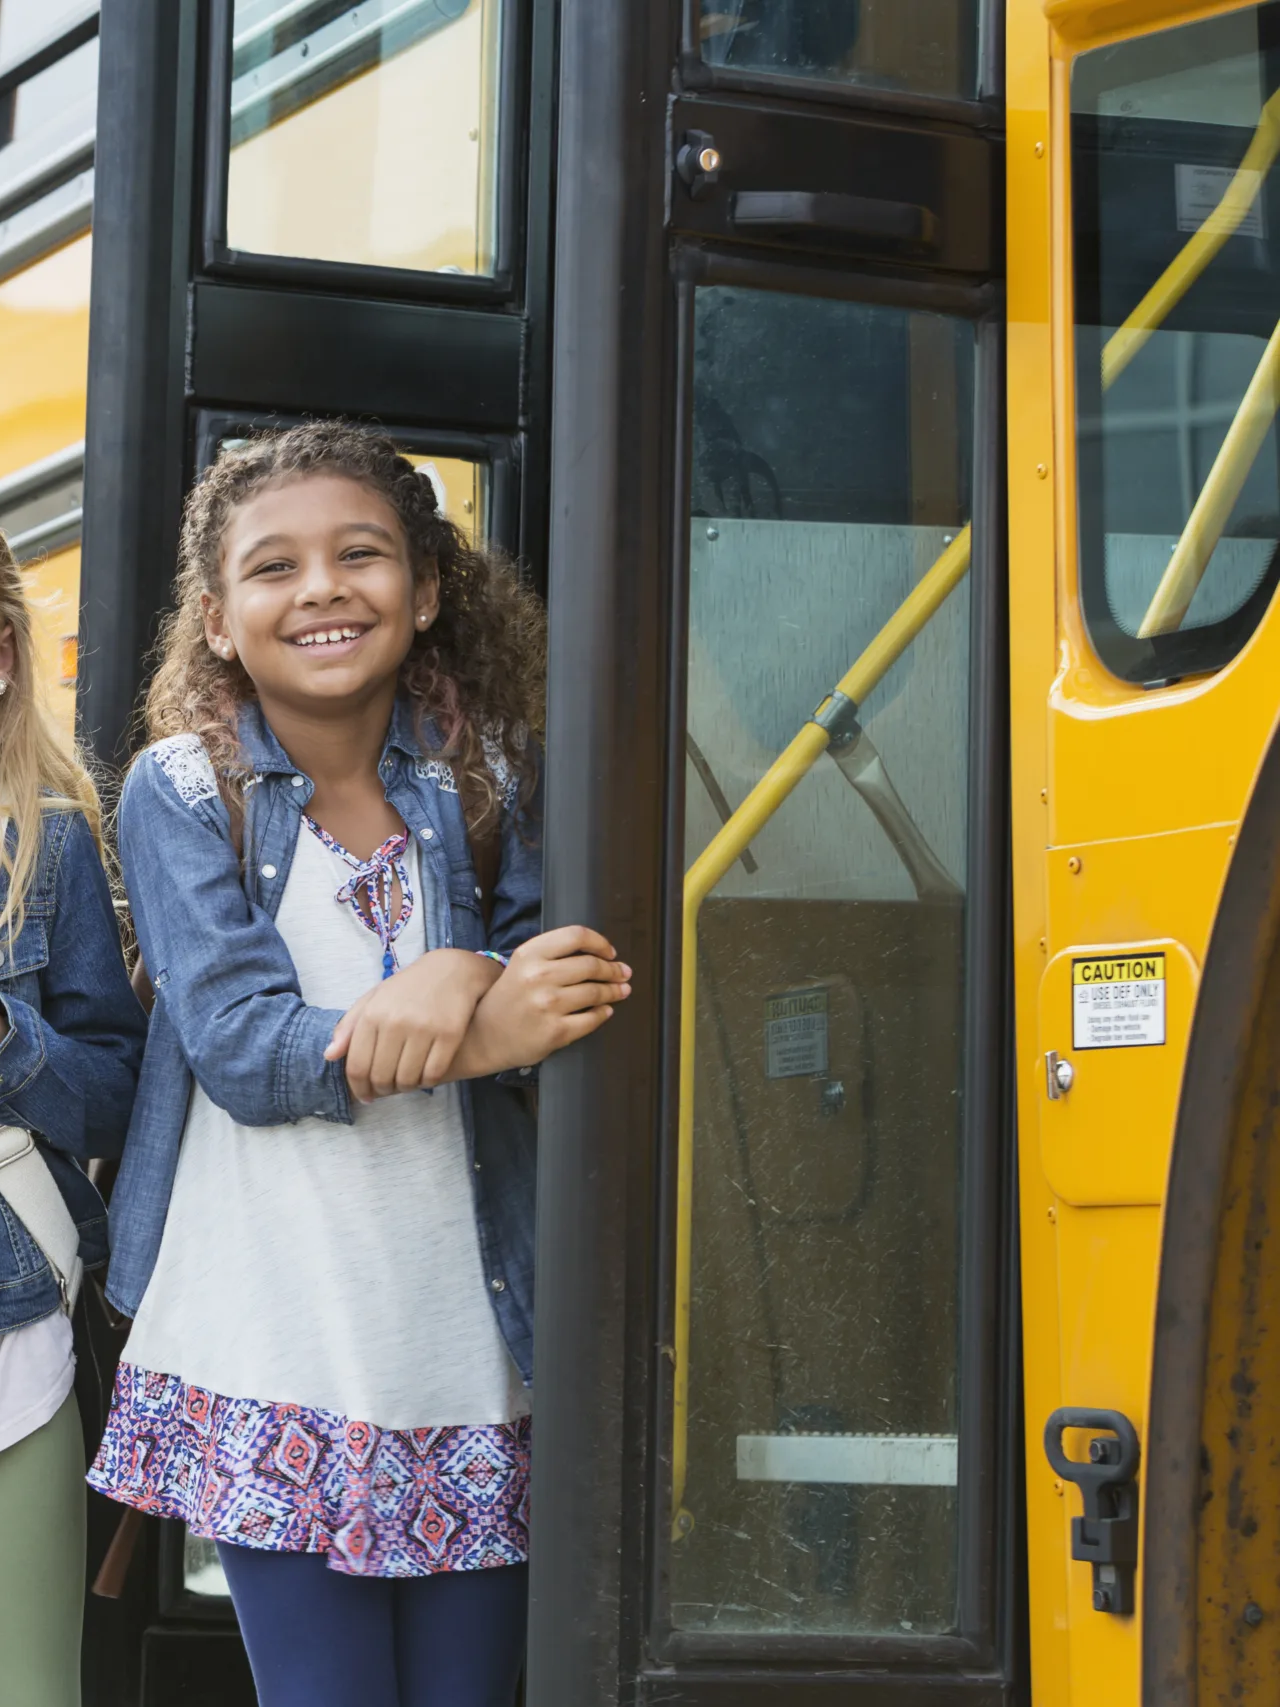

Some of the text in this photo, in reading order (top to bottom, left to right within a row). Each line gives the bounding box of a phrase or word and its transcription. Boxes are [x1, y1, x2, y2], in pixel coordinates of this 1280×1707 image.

[1082, 961, 1156, 981] CAUTION
[1091, 983, 1159, 1000] USE DEF ONLY
